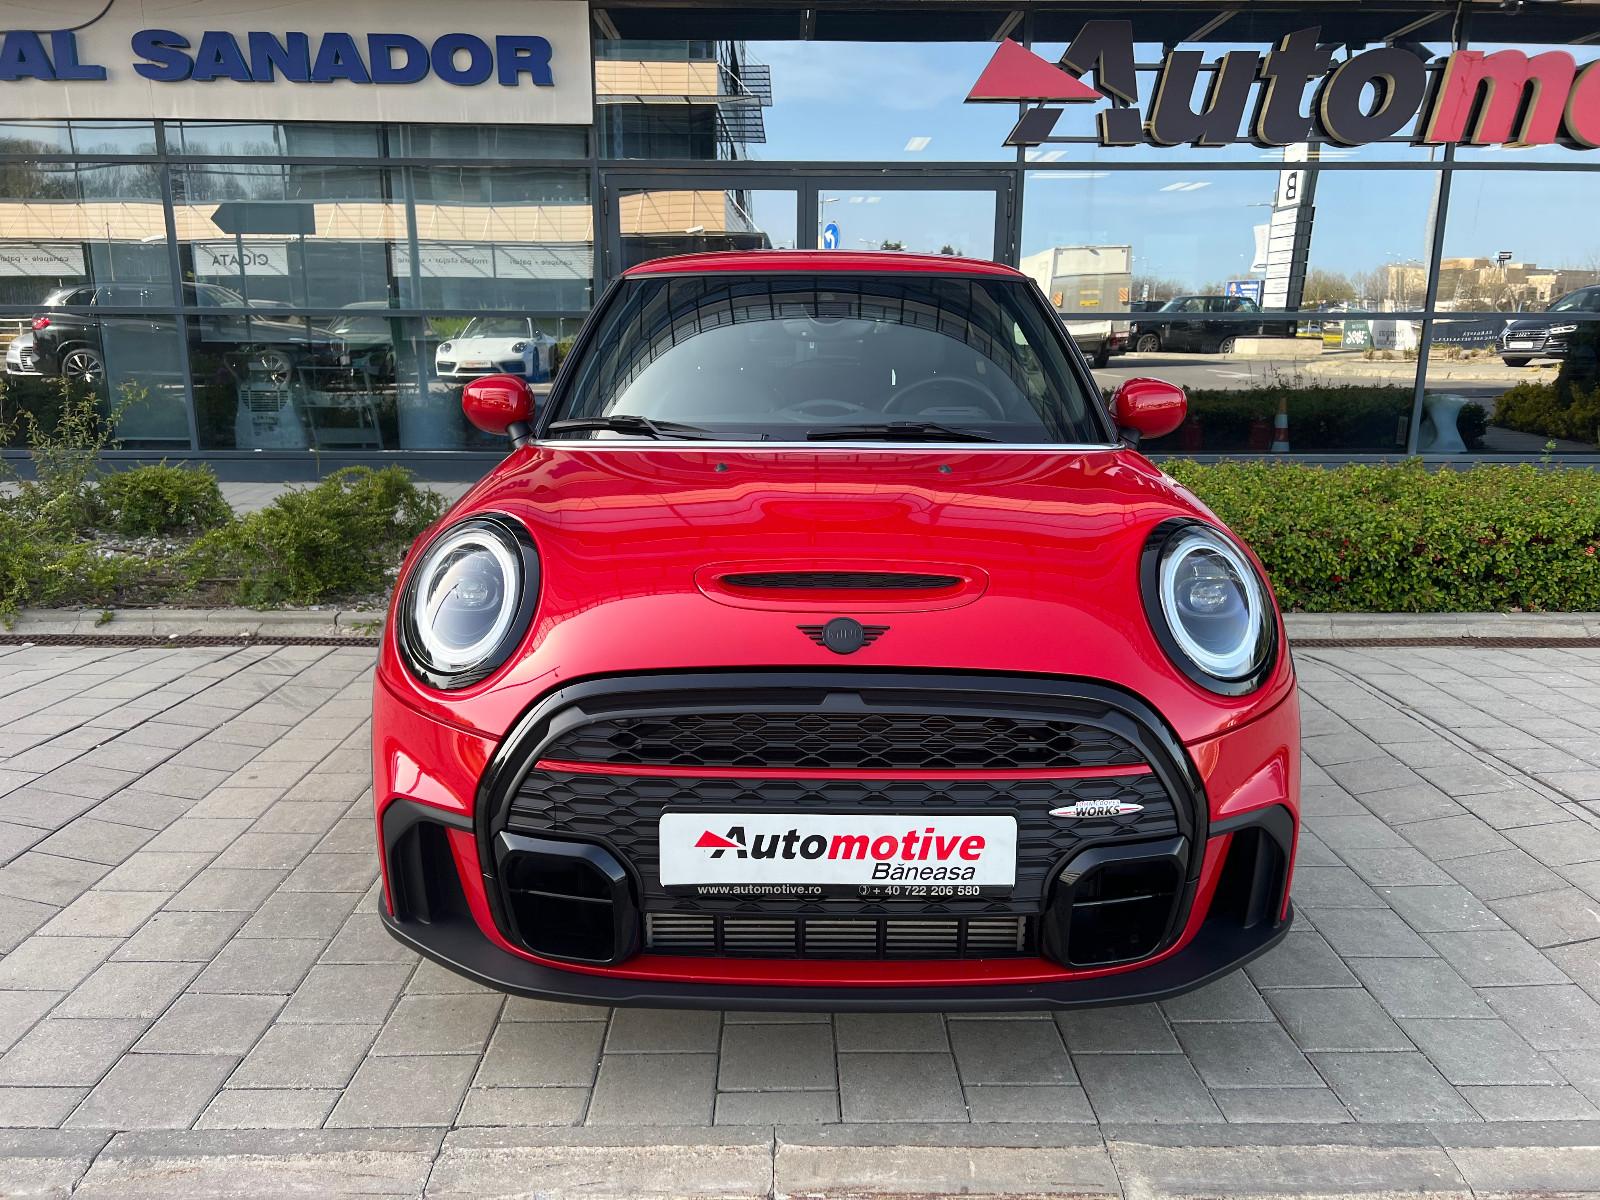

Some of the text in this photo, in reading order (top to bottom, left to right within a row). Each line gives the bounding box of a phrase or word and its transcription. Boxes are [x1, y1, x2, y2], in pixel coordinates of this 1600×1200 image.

[0, 29, 555, 87] AL SANADOR
[1002, 20, 1600, 150] Autom
[1076, 806, 1120, 816] WORKS
[710, 826, 986, 860] Automotive
[871, 862, 976, 881] Băneasa
[697, 884, 822, 896] www.automotive.ro
[884, 885, 900, 896] 40
[904, 885, 927, 896] 722
[930, 885, 954, 896] 206
[957, 885, 980, 896] 580
